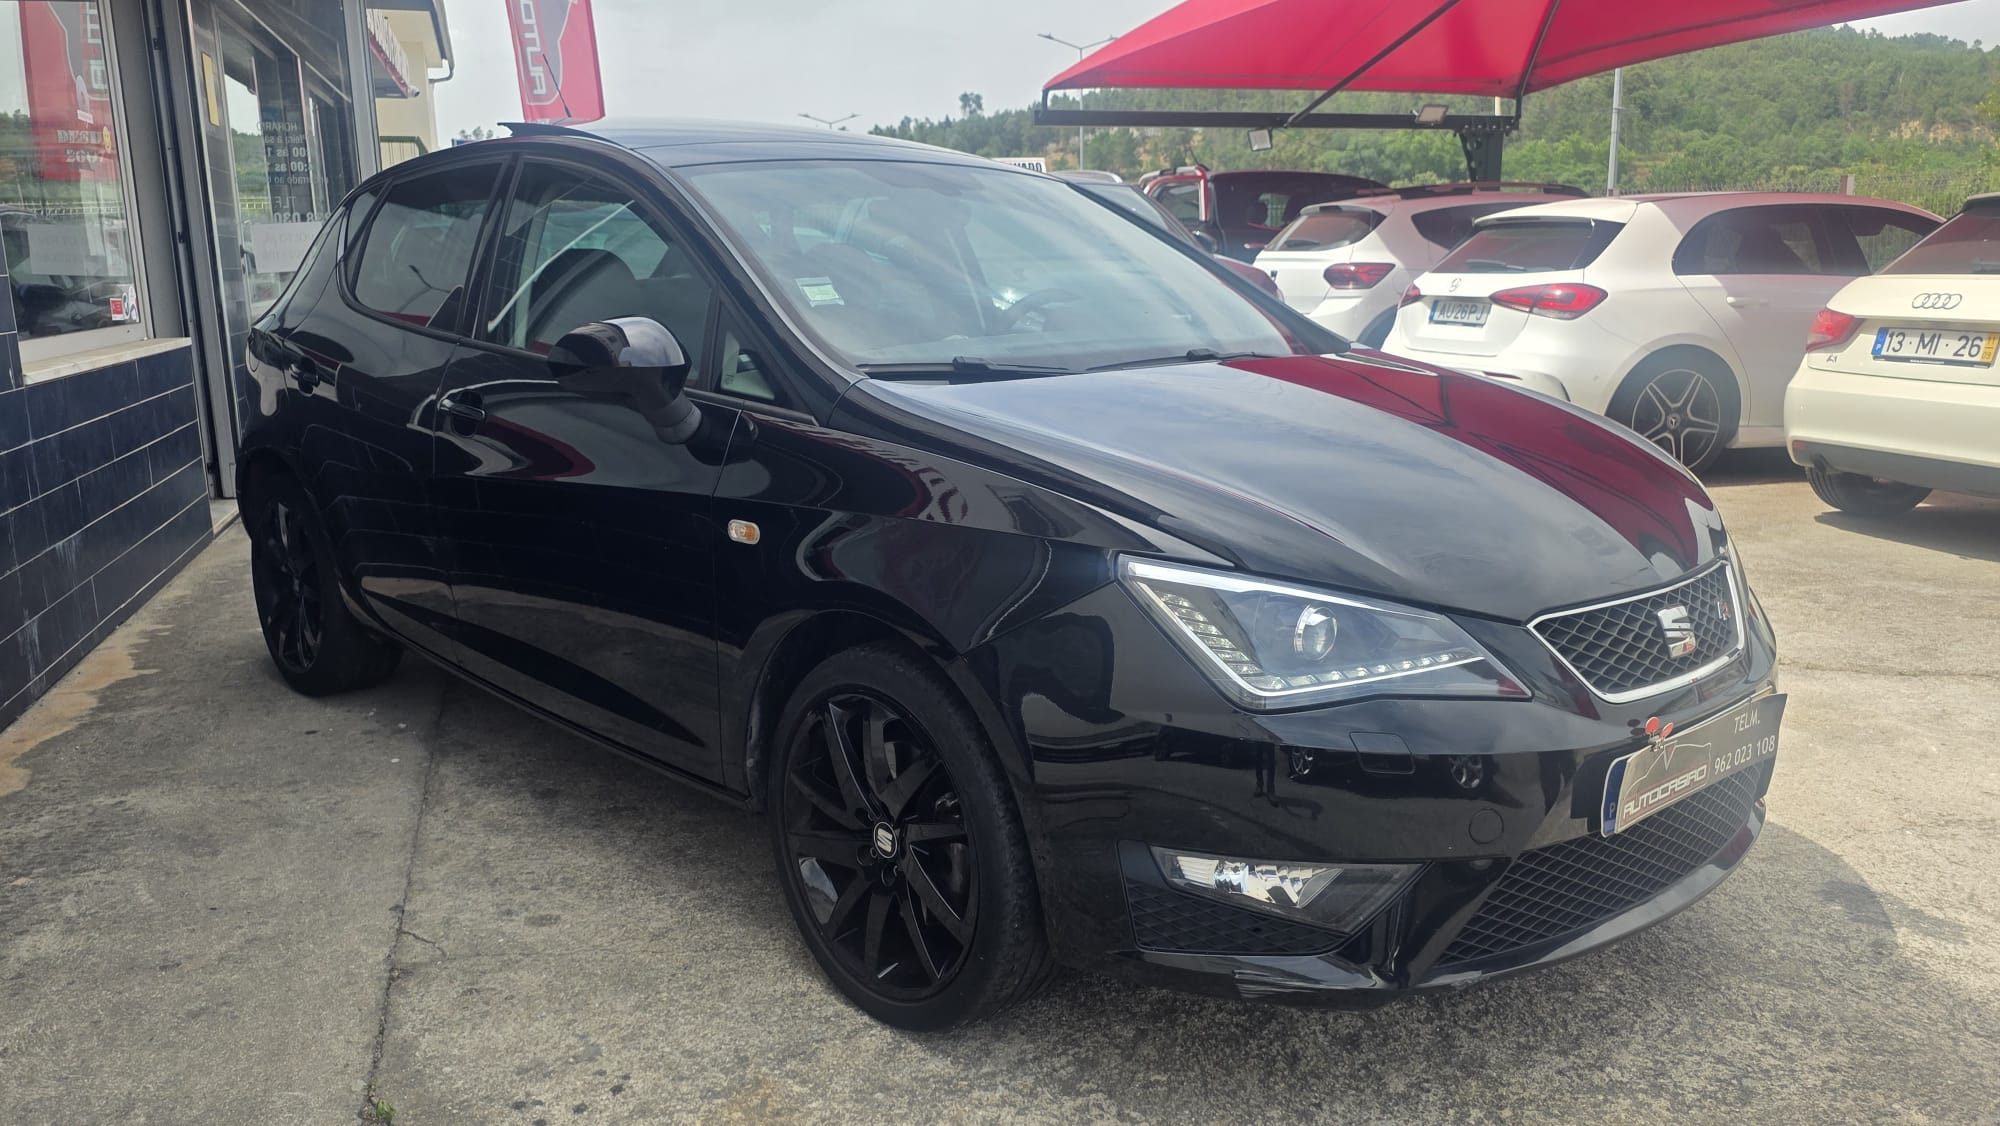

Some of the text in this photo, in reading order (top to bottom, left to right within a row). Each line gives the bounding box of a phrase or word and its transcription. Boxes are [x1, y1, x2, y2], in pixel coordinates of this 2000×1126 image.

[1734, 708, 1760, 734] TELM.
[1714, 735, 1775, 775] 962 023 108
